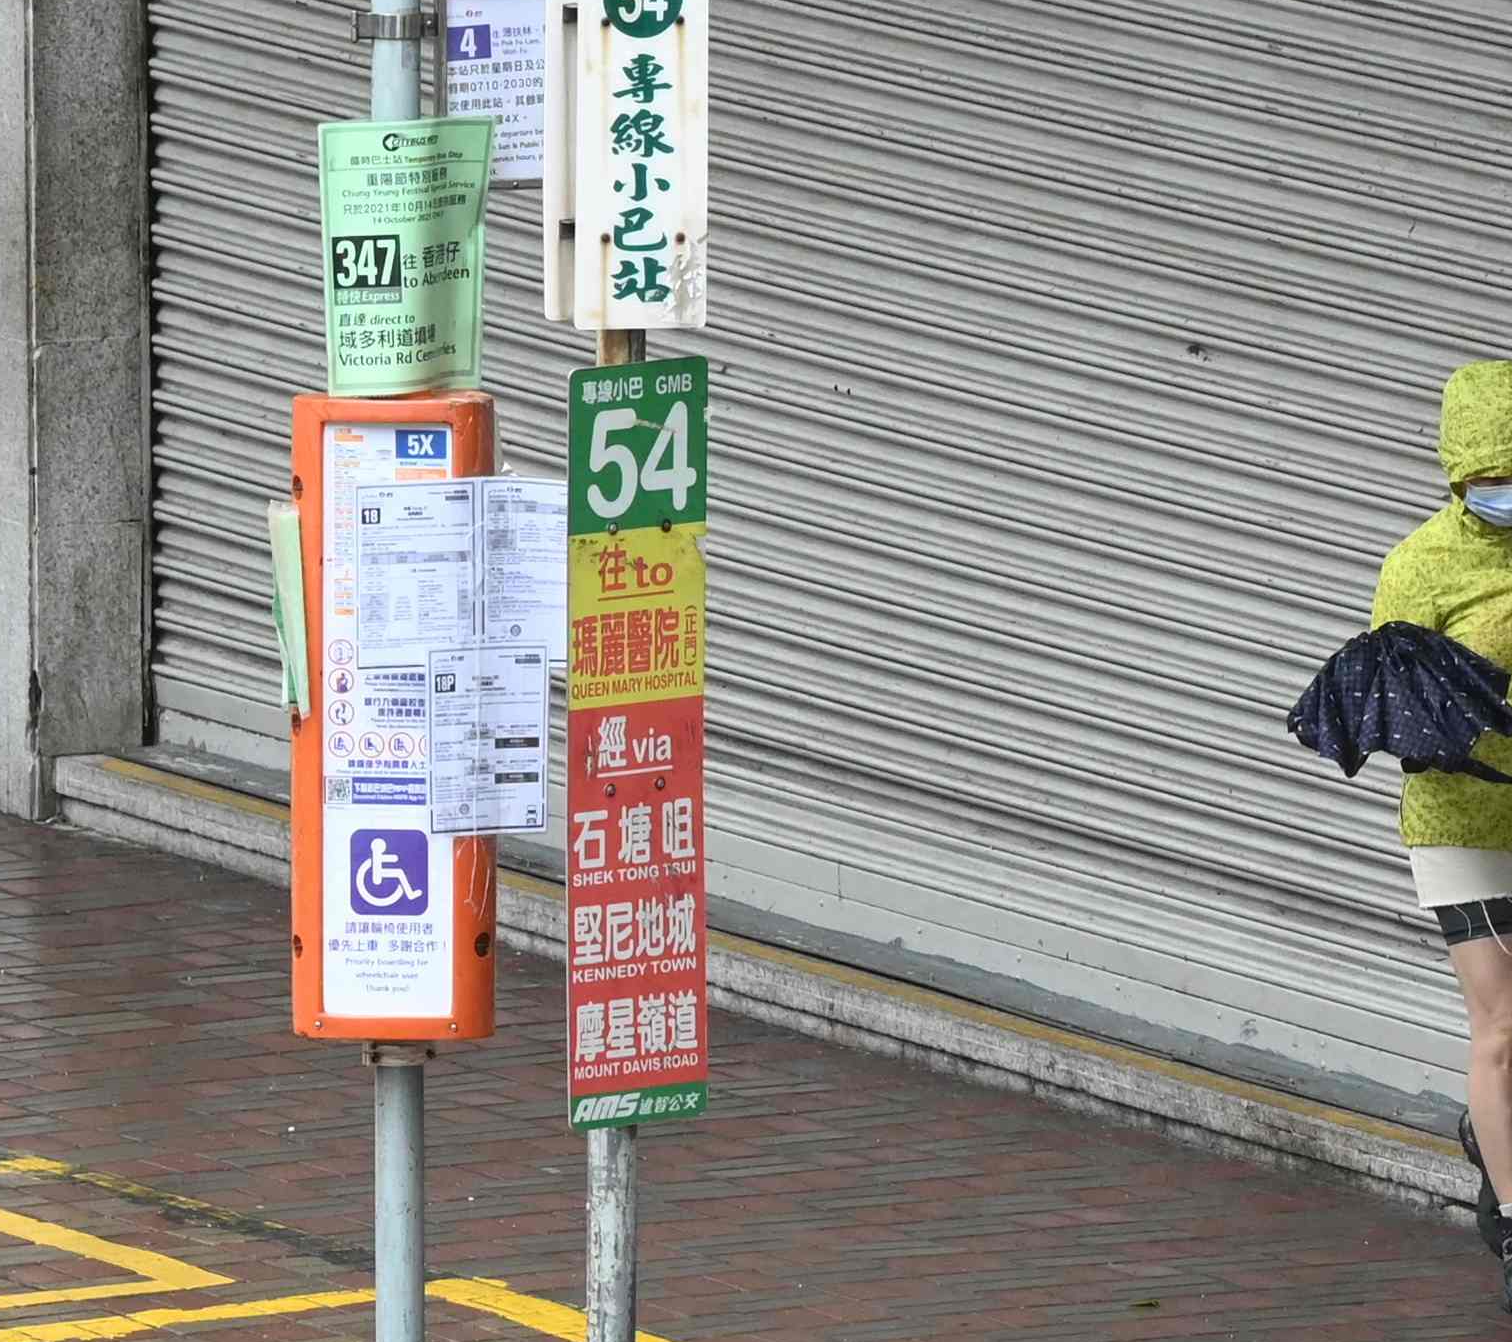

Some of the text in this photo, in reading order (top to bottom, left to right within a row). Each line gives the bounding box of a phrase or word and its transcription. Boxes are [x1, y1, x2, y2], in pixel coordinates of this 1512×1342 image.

[459, 28, 478, 59] 4
[609, 52, 676, 305] 專線小巴站
[335, 239, 397, 287] 347
[403, 253, 417, 270] 往
[362, 290, 400, 303] Express
[403, 275, 418, 289] to
[369, 313, 416, 324] direct to
[338, 350, 412, 367] Victoria Rd
[581, 373, 693, 406] 專線小巴 GMB
[407, 434, 435, 456] 5X
[586, 400, 698, 519] 54
[361, 509, 379, 524] 18
[598, 544, 673, 594] 往 to
[571, 610, 681, 678] 瑪麗醫院
[435, 674, 455, 692] 18P
[571, 672, 698, 701] QUEEN MARY HOSPITAL
[597, 715, 673, 769] 經 via
[573, 797, 697, 871] 石塘咀
[572, 860, 697, 888] SHEK TONG TSUI
[573, 892, 697, 967] 堅尼地城
[572, 957, 698, 984] KENNEDY TOWN
[575, 989, 698, 1063] 摩星嶺道
[573, 1052, 699, 1081] MOUNT DAVIS ROAD
[572, 1092, 641, 1124] AMS
